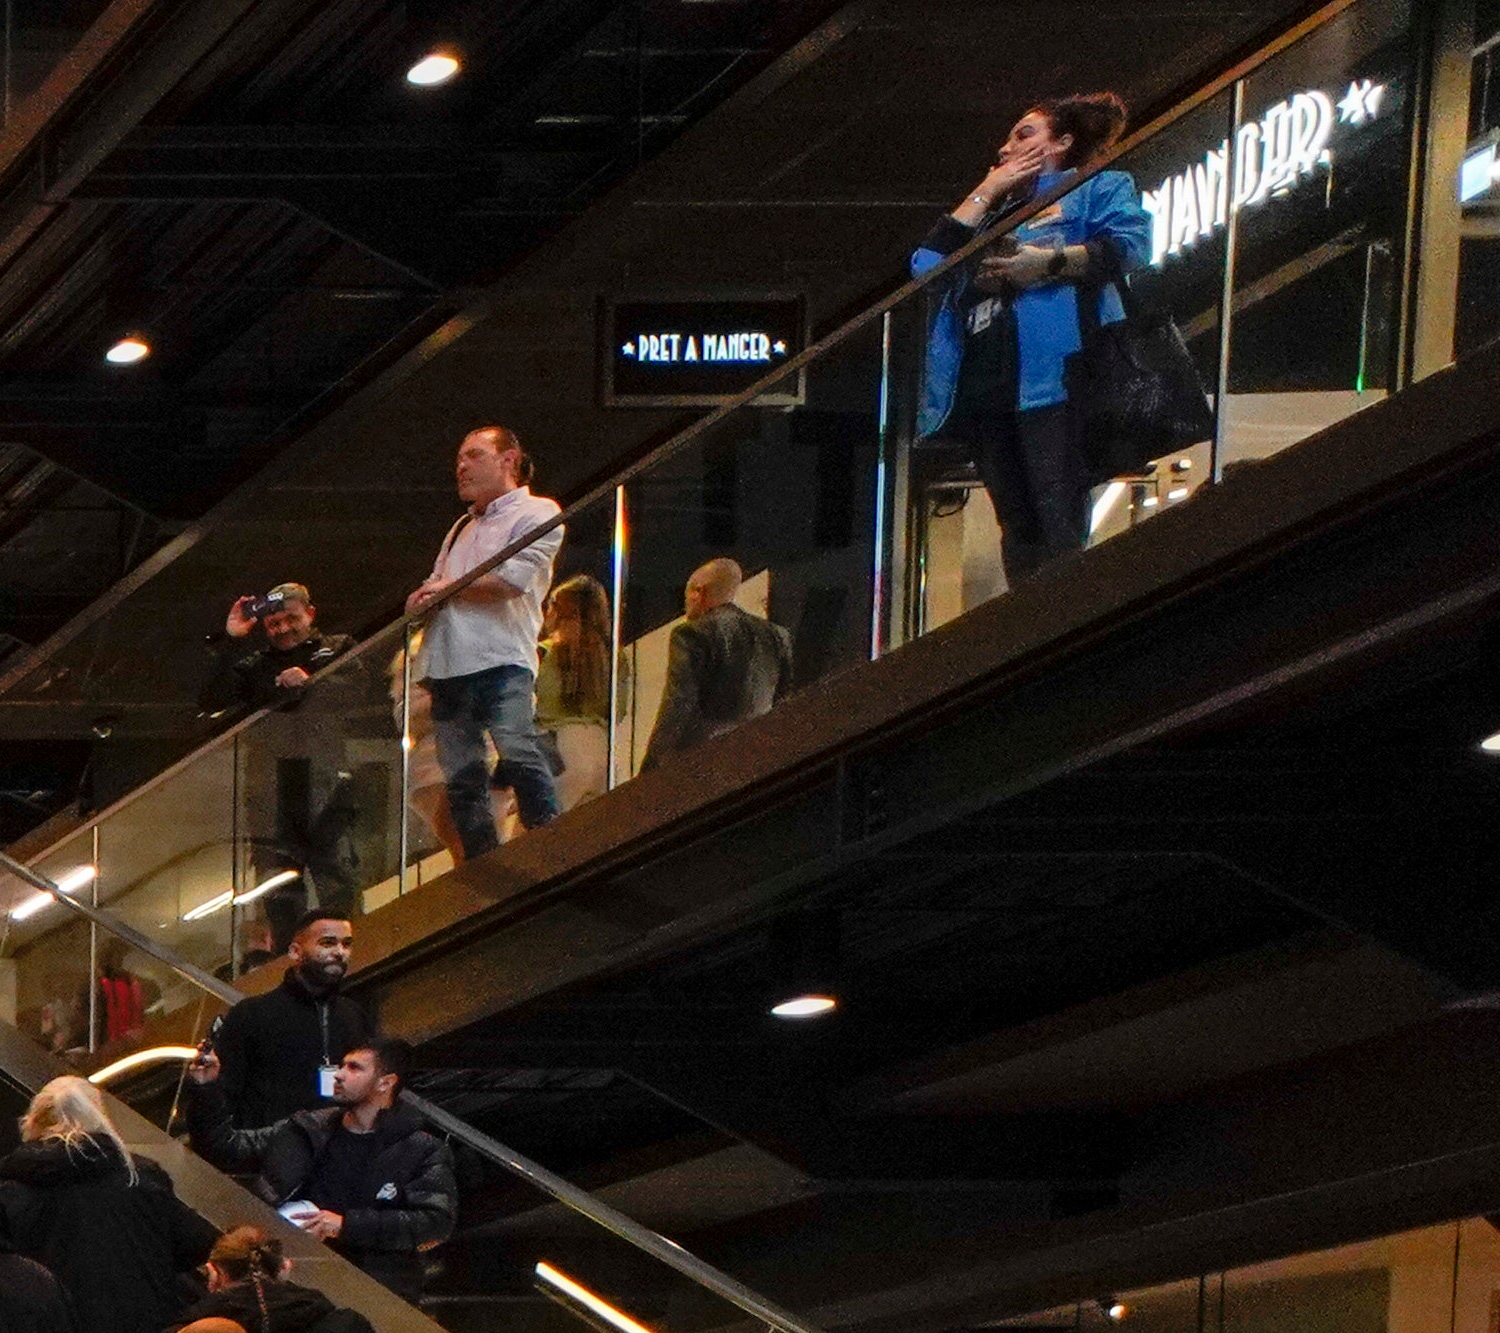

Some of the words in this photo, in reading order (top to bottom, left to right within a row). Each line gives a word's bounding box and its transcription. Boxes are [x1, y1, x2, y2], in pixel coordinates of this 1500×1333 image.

[638, 334, 681, 361] PRET
[684, 335, 698, 361] A
[703, 333, 770, 361] MANGER
